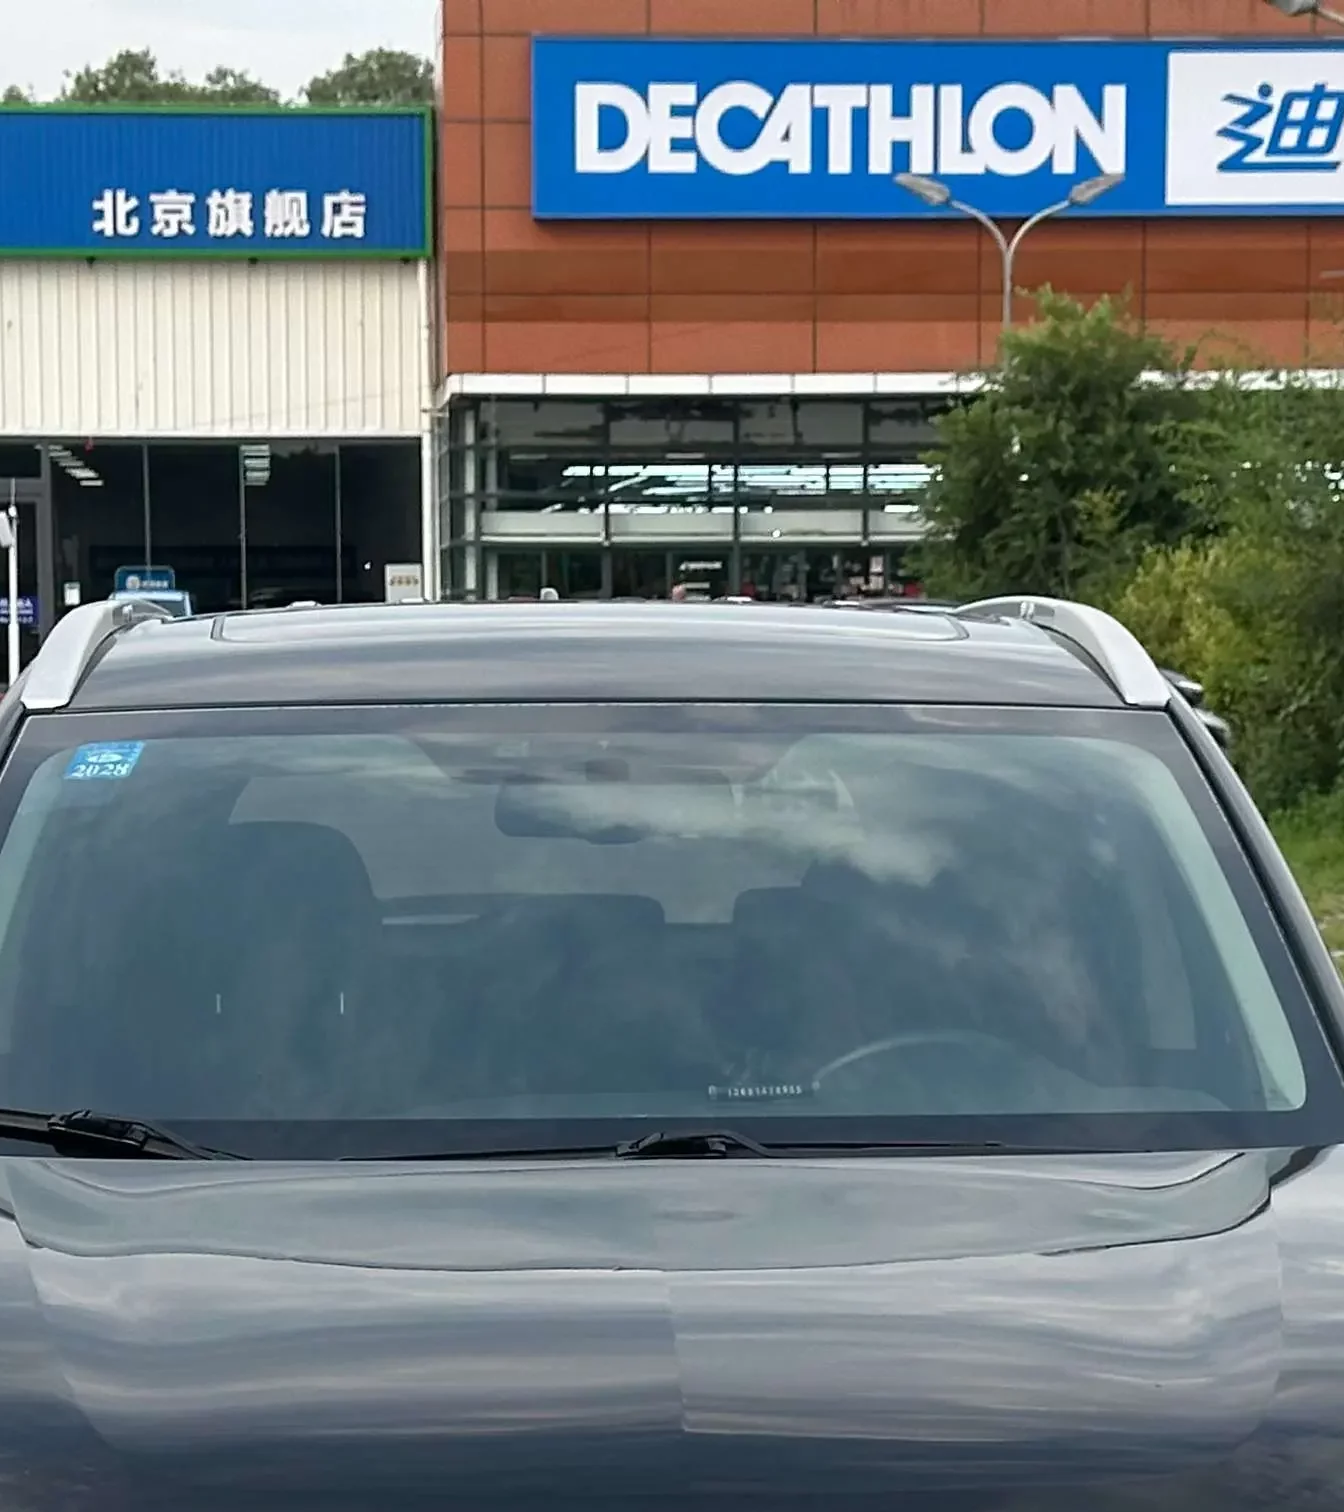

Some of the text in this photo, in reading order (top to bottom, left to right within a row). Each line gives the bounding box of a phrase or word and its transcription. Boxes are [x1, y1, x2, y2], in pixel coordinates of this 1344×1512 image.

[574, 82, 1127, 176] DECATHLON
[92, 187, 367, 239] 北京旗舰店
